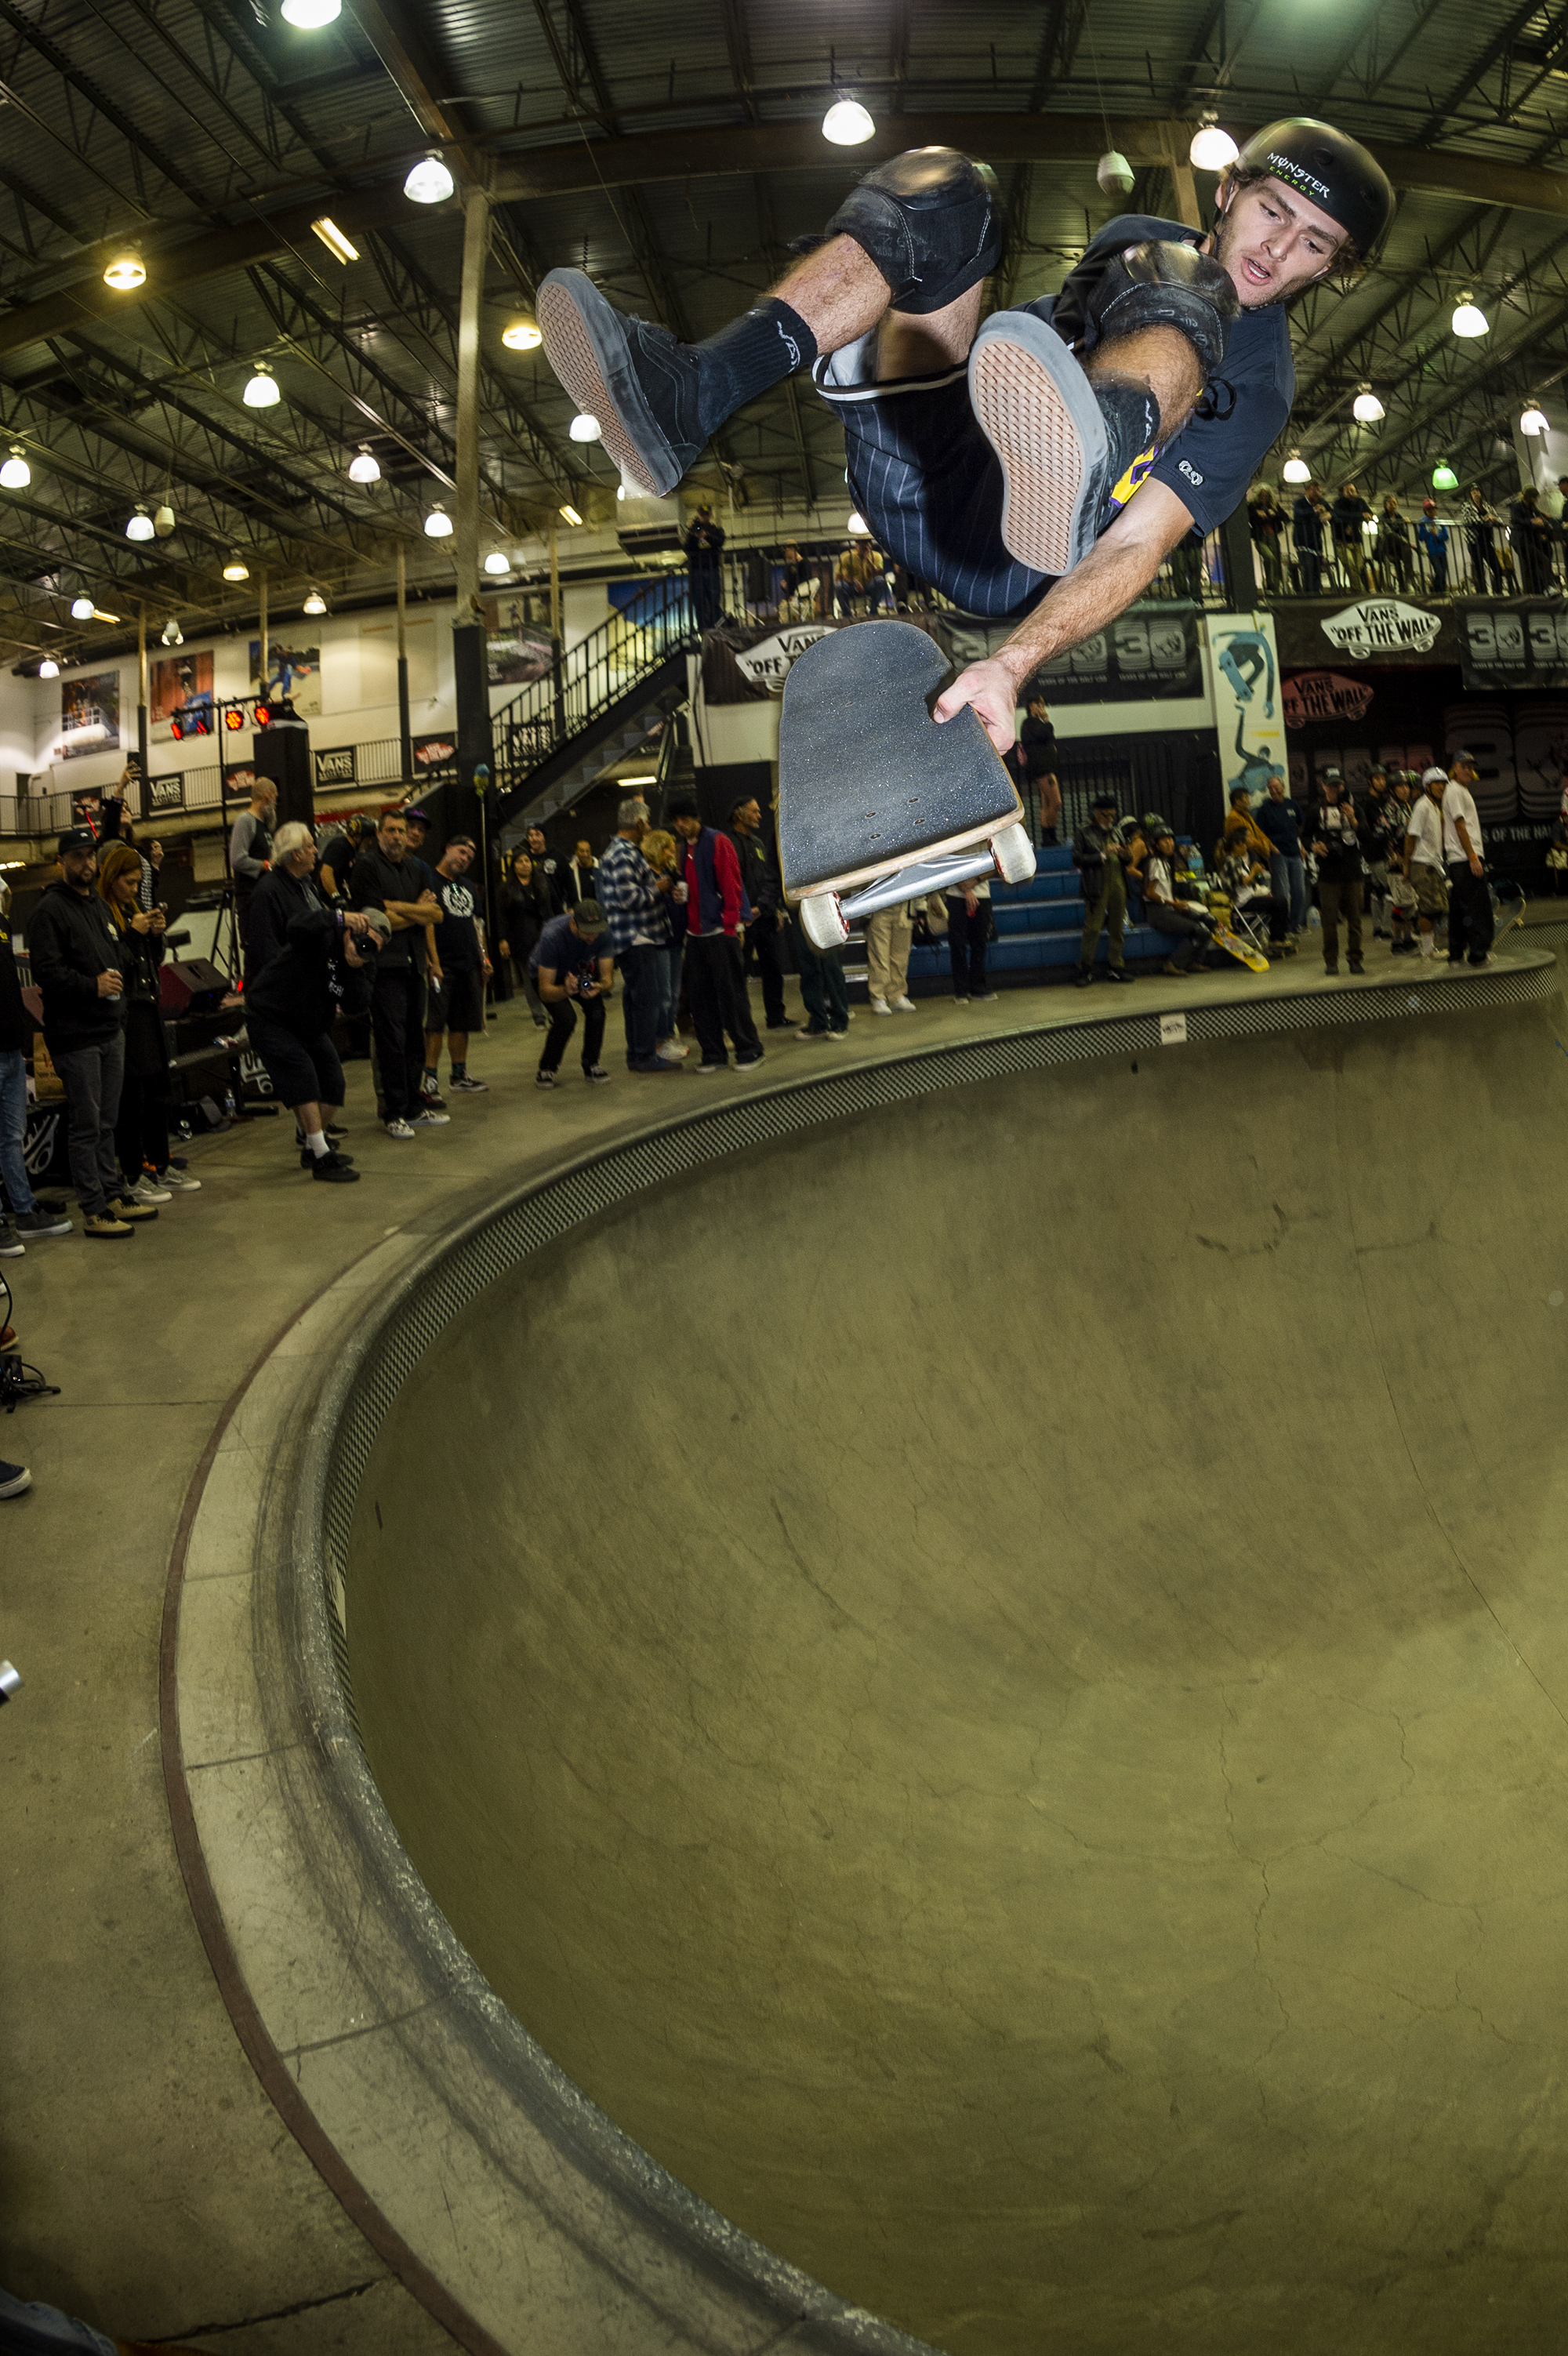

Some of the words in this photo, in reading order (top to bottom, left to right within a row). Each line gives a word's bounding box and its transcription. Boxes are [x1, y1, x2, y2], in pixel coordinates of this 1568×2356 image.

[1267, 152, 1330, 198] MONSTER
[1269, 165, 1315, 196] ENERGY
[1355, 601, 1399, 625] VANS
[775, 628, 826, 654] VAN
[1363, 623, 1399, 645] THE
[1293, 676, 1334, 695] VANS
[1301, 695, 1334, 717] THE
[317, 750, 353, 771] VANS
[150, 776, 181, 798] VANS
